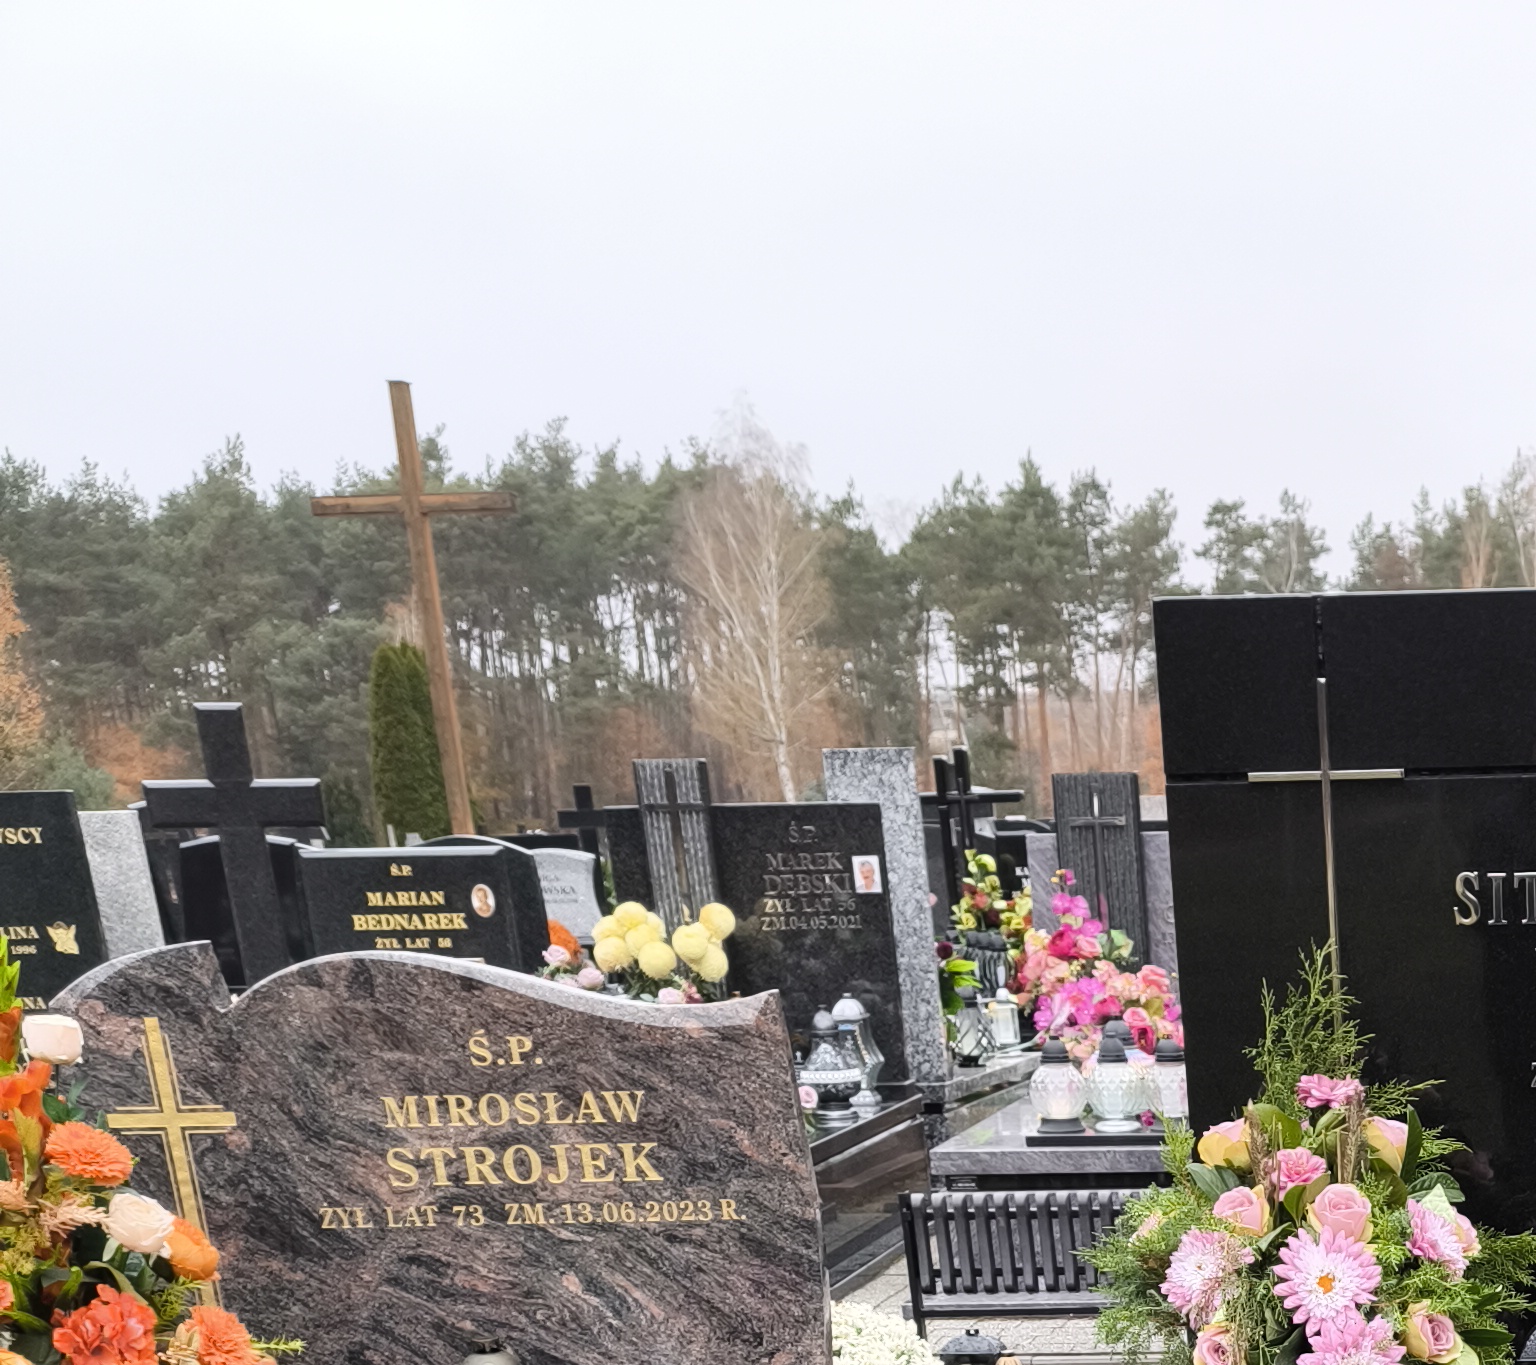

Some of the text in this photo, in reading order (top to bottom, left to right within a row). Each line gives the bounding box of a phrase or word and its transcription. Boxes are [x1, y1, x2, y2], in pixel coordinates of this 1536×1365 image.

[765, 852, 844, 871] MAREK
[366, 890, 446, 907] MARIAN
[801, 897, 833, 913] LAT
[350, 912, 470, 931] BEDNAREK
[468, 1029, 544, 1068] Ś.P.
[380, 1090, 646, 1130] MIROSŁAW
[385, 1141, 664, 1189] STROJEK
[318, 1202, 374, 1230] ŻYŁ
[384, 1206, 439, 1228] LAT
[452, 1204, 485, 1226] 73
